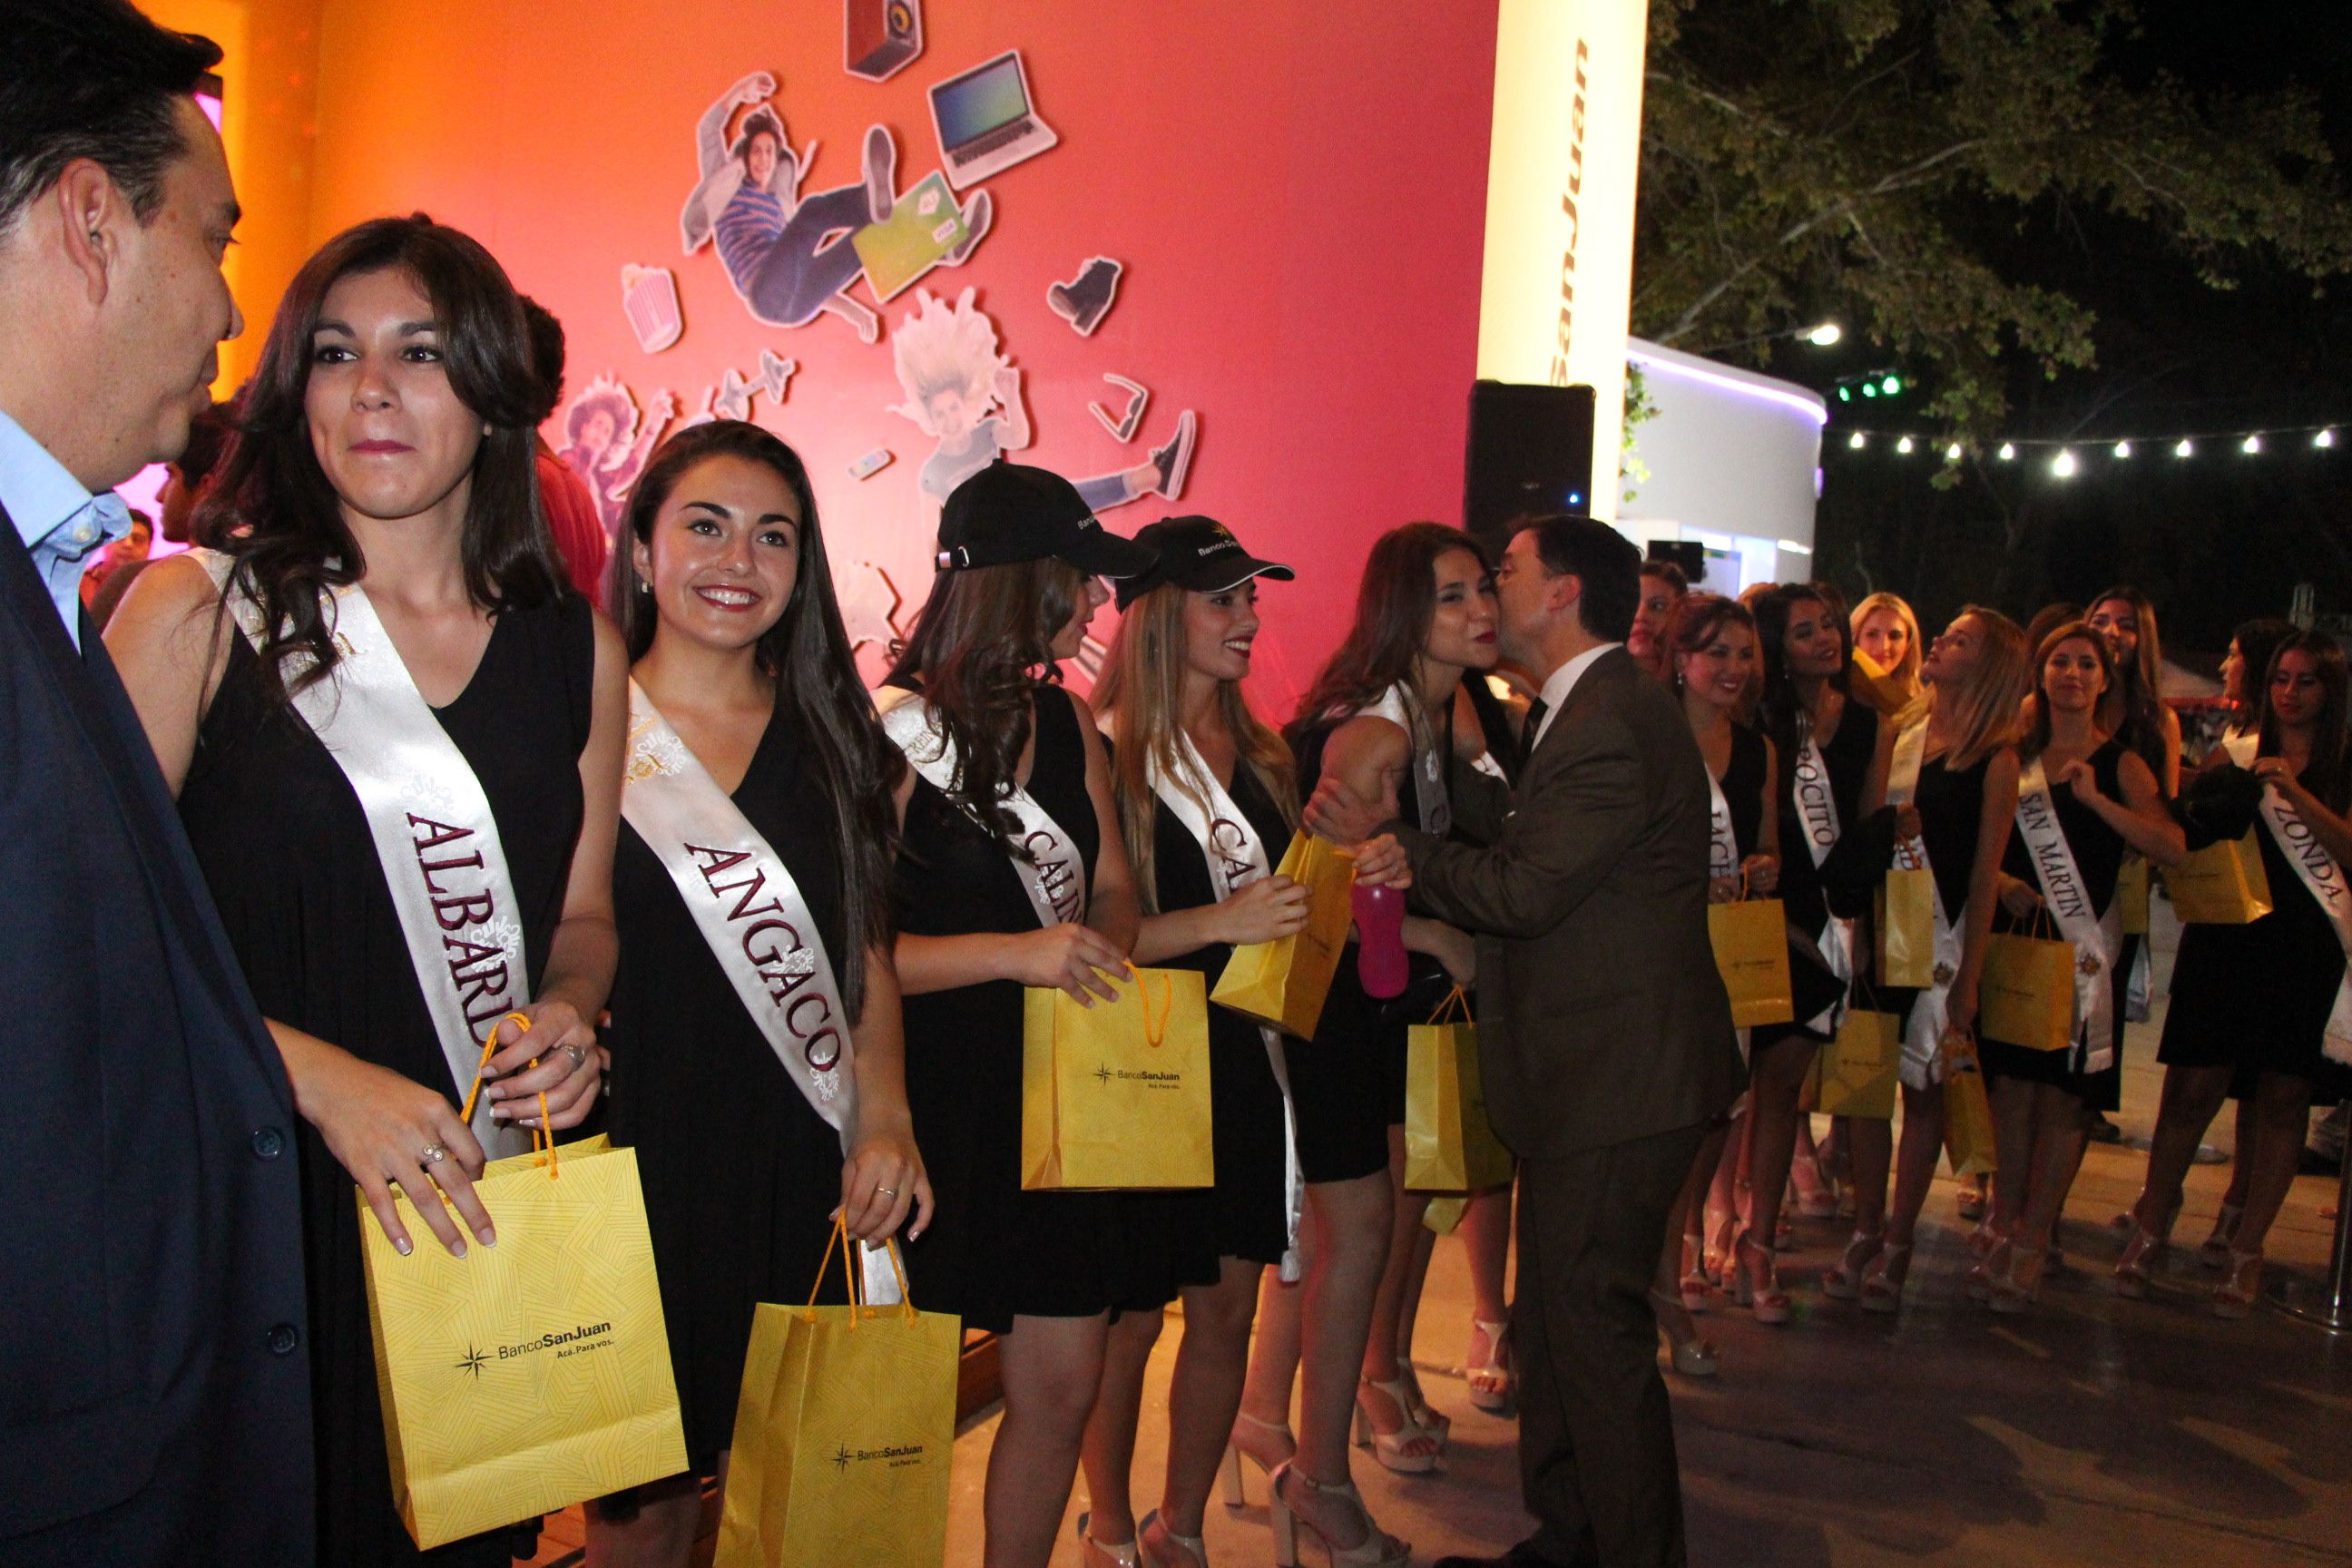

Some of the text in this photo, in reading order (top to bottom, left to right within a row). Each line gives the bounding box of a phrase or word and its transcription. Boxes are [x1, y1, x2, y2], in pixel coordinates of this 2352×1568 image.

[1024, 830, 1082, 924] CALIN
[2019, 792, 2086, 918] SAN MARTIN
[406, 812, 514, 1048] ALBARD
[684, 841, 841, 1073] ANGACO
[1117, 1070, 1180, 1081] BancoSanJuan
[498, 1321, 612, 1359] BancoSanJuan
[575, 1343, 595, 1354] Para
[857, 1444, 923, 1461] BancoSanJuan
